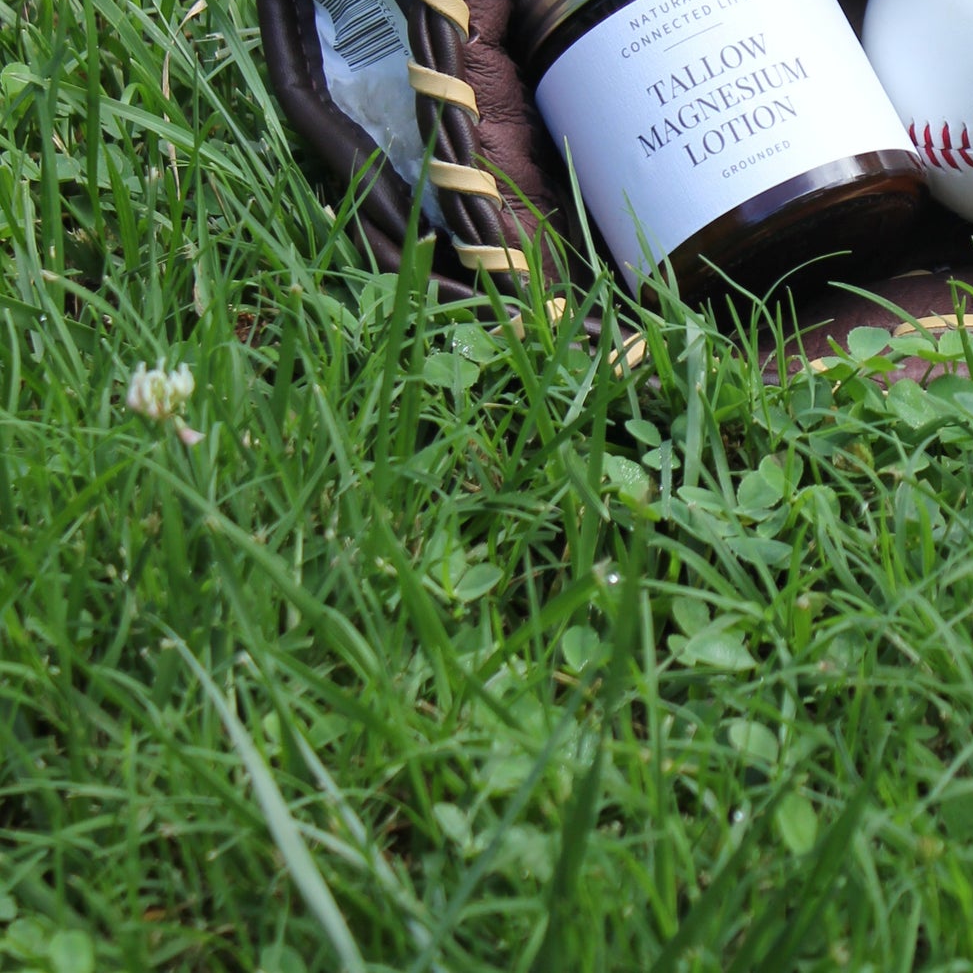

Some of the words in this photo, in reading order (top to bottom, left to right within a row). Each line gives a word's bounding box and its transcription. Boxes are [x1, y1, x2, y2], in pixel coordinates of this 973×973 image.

[621, 4, 712, 59] CONNECTED
[646, 33, 767, 107] TALLOW
[636, 57, 810, 158] MAGNESIUM
[682, 95, 798, 167] LOTION
[721, 140, 791, 179] GROUNDED
